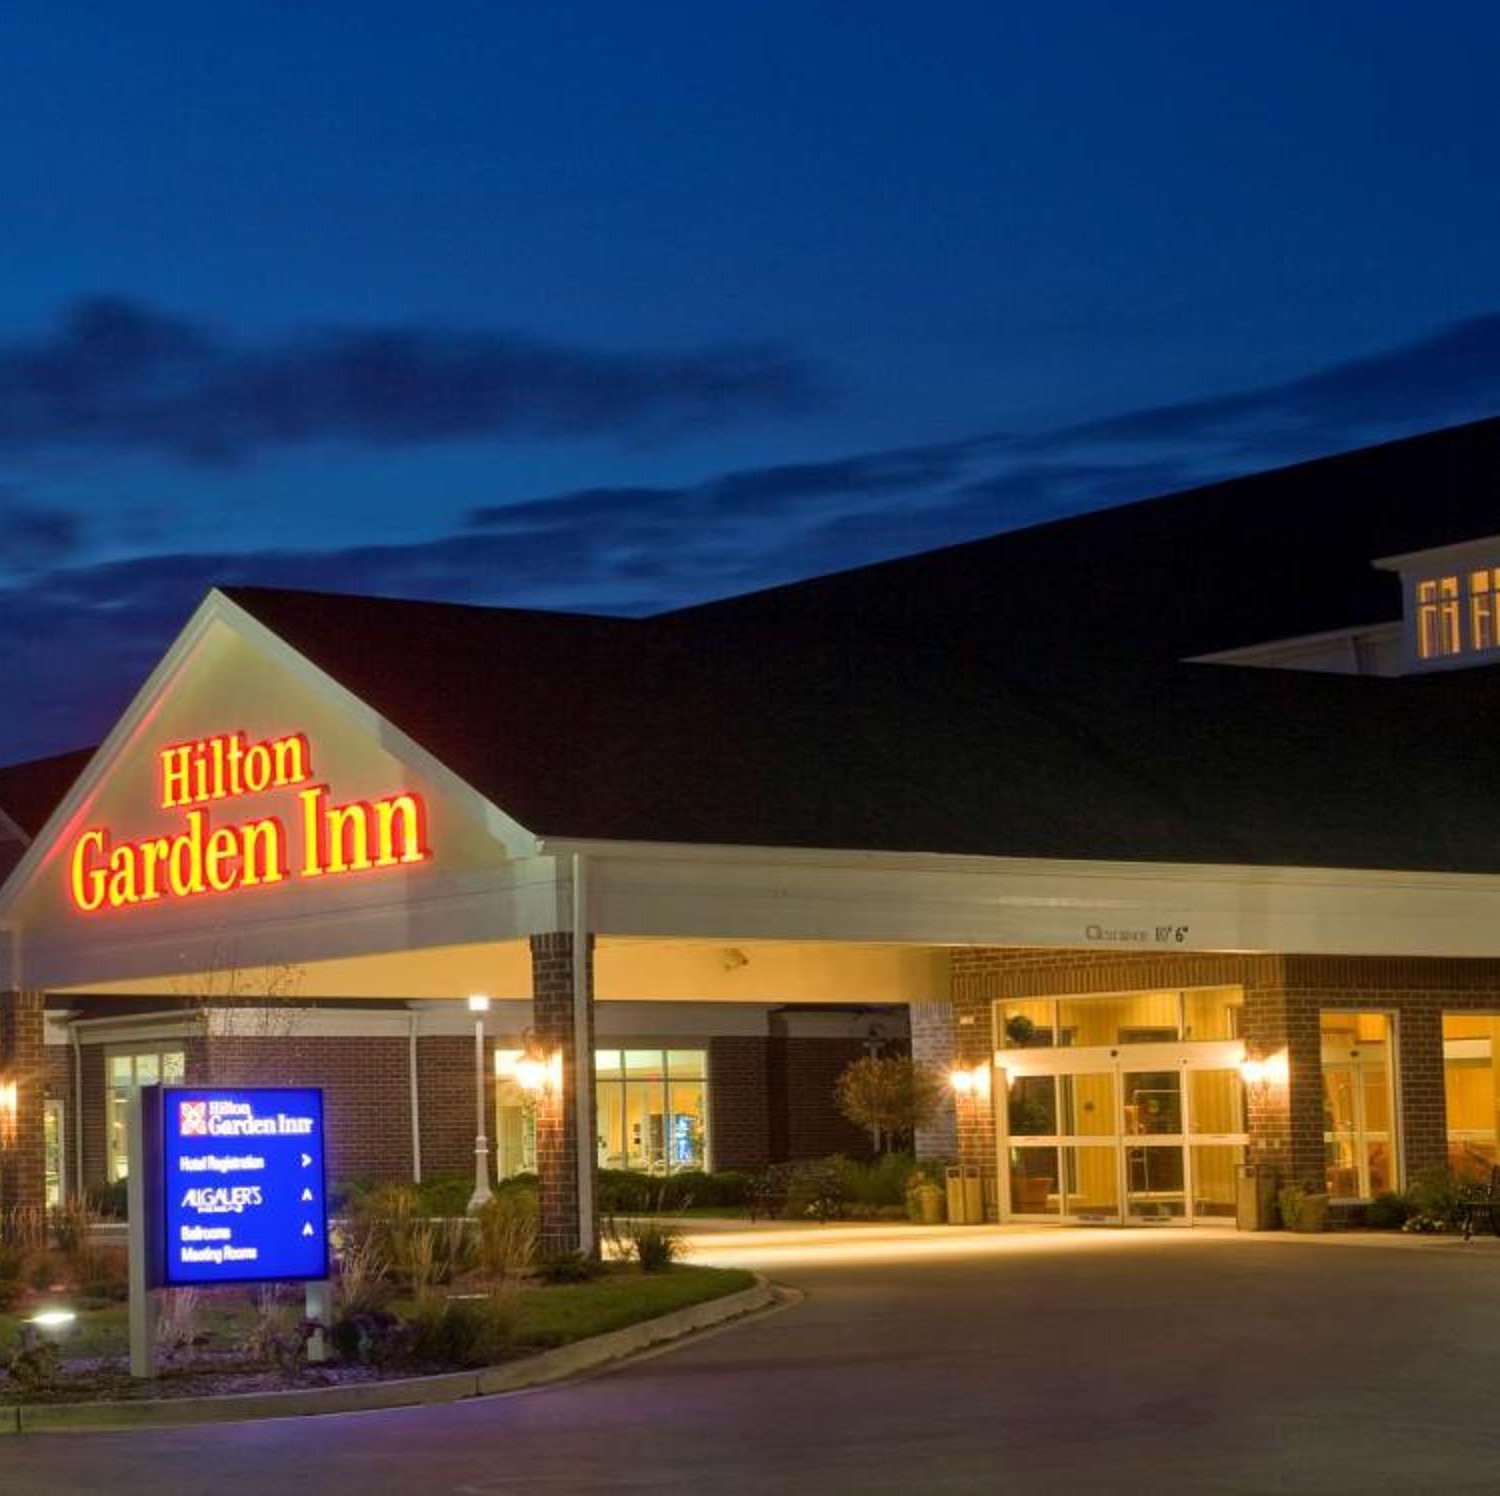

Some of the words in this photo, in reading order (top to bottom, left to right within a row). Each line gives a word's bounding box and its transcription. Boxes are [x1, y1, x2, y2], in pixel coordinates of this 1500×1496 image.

[161, 731, 311, 808] Hilton
[71, 808, 287, 911] Garden
[300, 786, 427, 878] Inn
[208, 1101, 251, 1116] Hilton
[207, 1115, 277, 1135] Garden
[278, 1114, 313, 1134] Inn
[180, 1156, 207, 1171] Hotel
[207, 1155, 265, 1173] Registration
[181, 1246, 223, 1264] Meeting
[223, 1245, 258, 1261] Rooms
